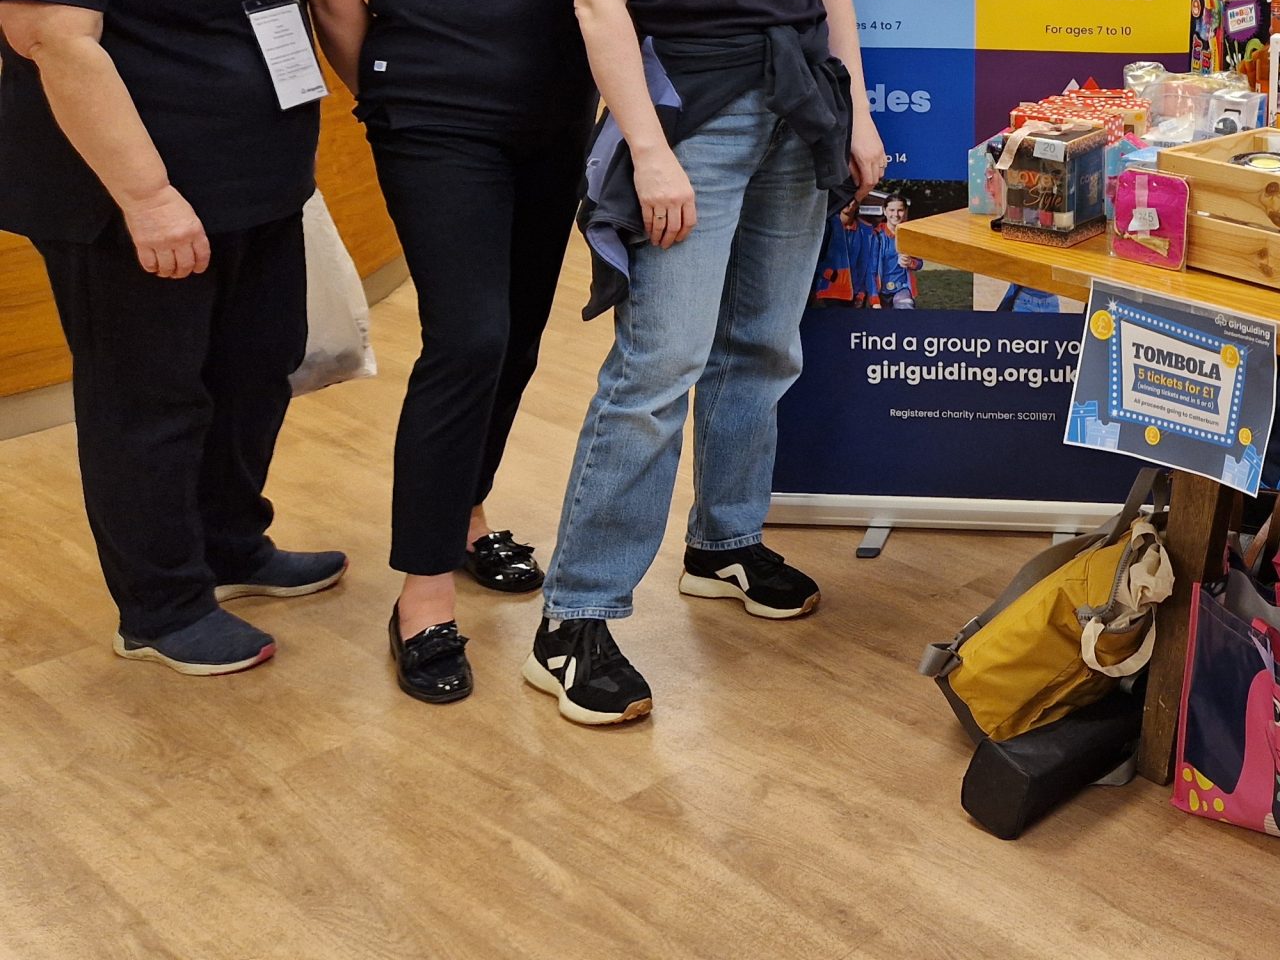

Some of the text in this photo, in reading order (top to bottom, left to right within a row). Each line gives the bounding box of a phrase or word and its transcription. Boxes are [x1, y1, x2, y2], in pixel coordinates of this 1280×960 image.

[869, 21, 878, 31] 4
[880, 21, 892, 31] to
[894, 21, 902, 31] 7
[1044, 24, 1132, 39] For ages 7 to 10
[1042, 143, 1057, 154] 20
[895, 152, 907, 163] 14
[1228, 320, 1271, 340] Girlguiding
[850, 331, 897, 352] Find
[902, 336, 918, 352] a
[923, 336, 991, 358] group
[997, 338, 1048, 354] near
[1131, 342, 1222, 382] TOMBOLA
[866, 359, 1078, 388] girlguiding.org.uk
[1138, 367, 1215, 399] 5 tickets for £1
[1161, 389, 1179, 399] tickets
[890, 407, 1057, 422] Registered charity number: SC011971
